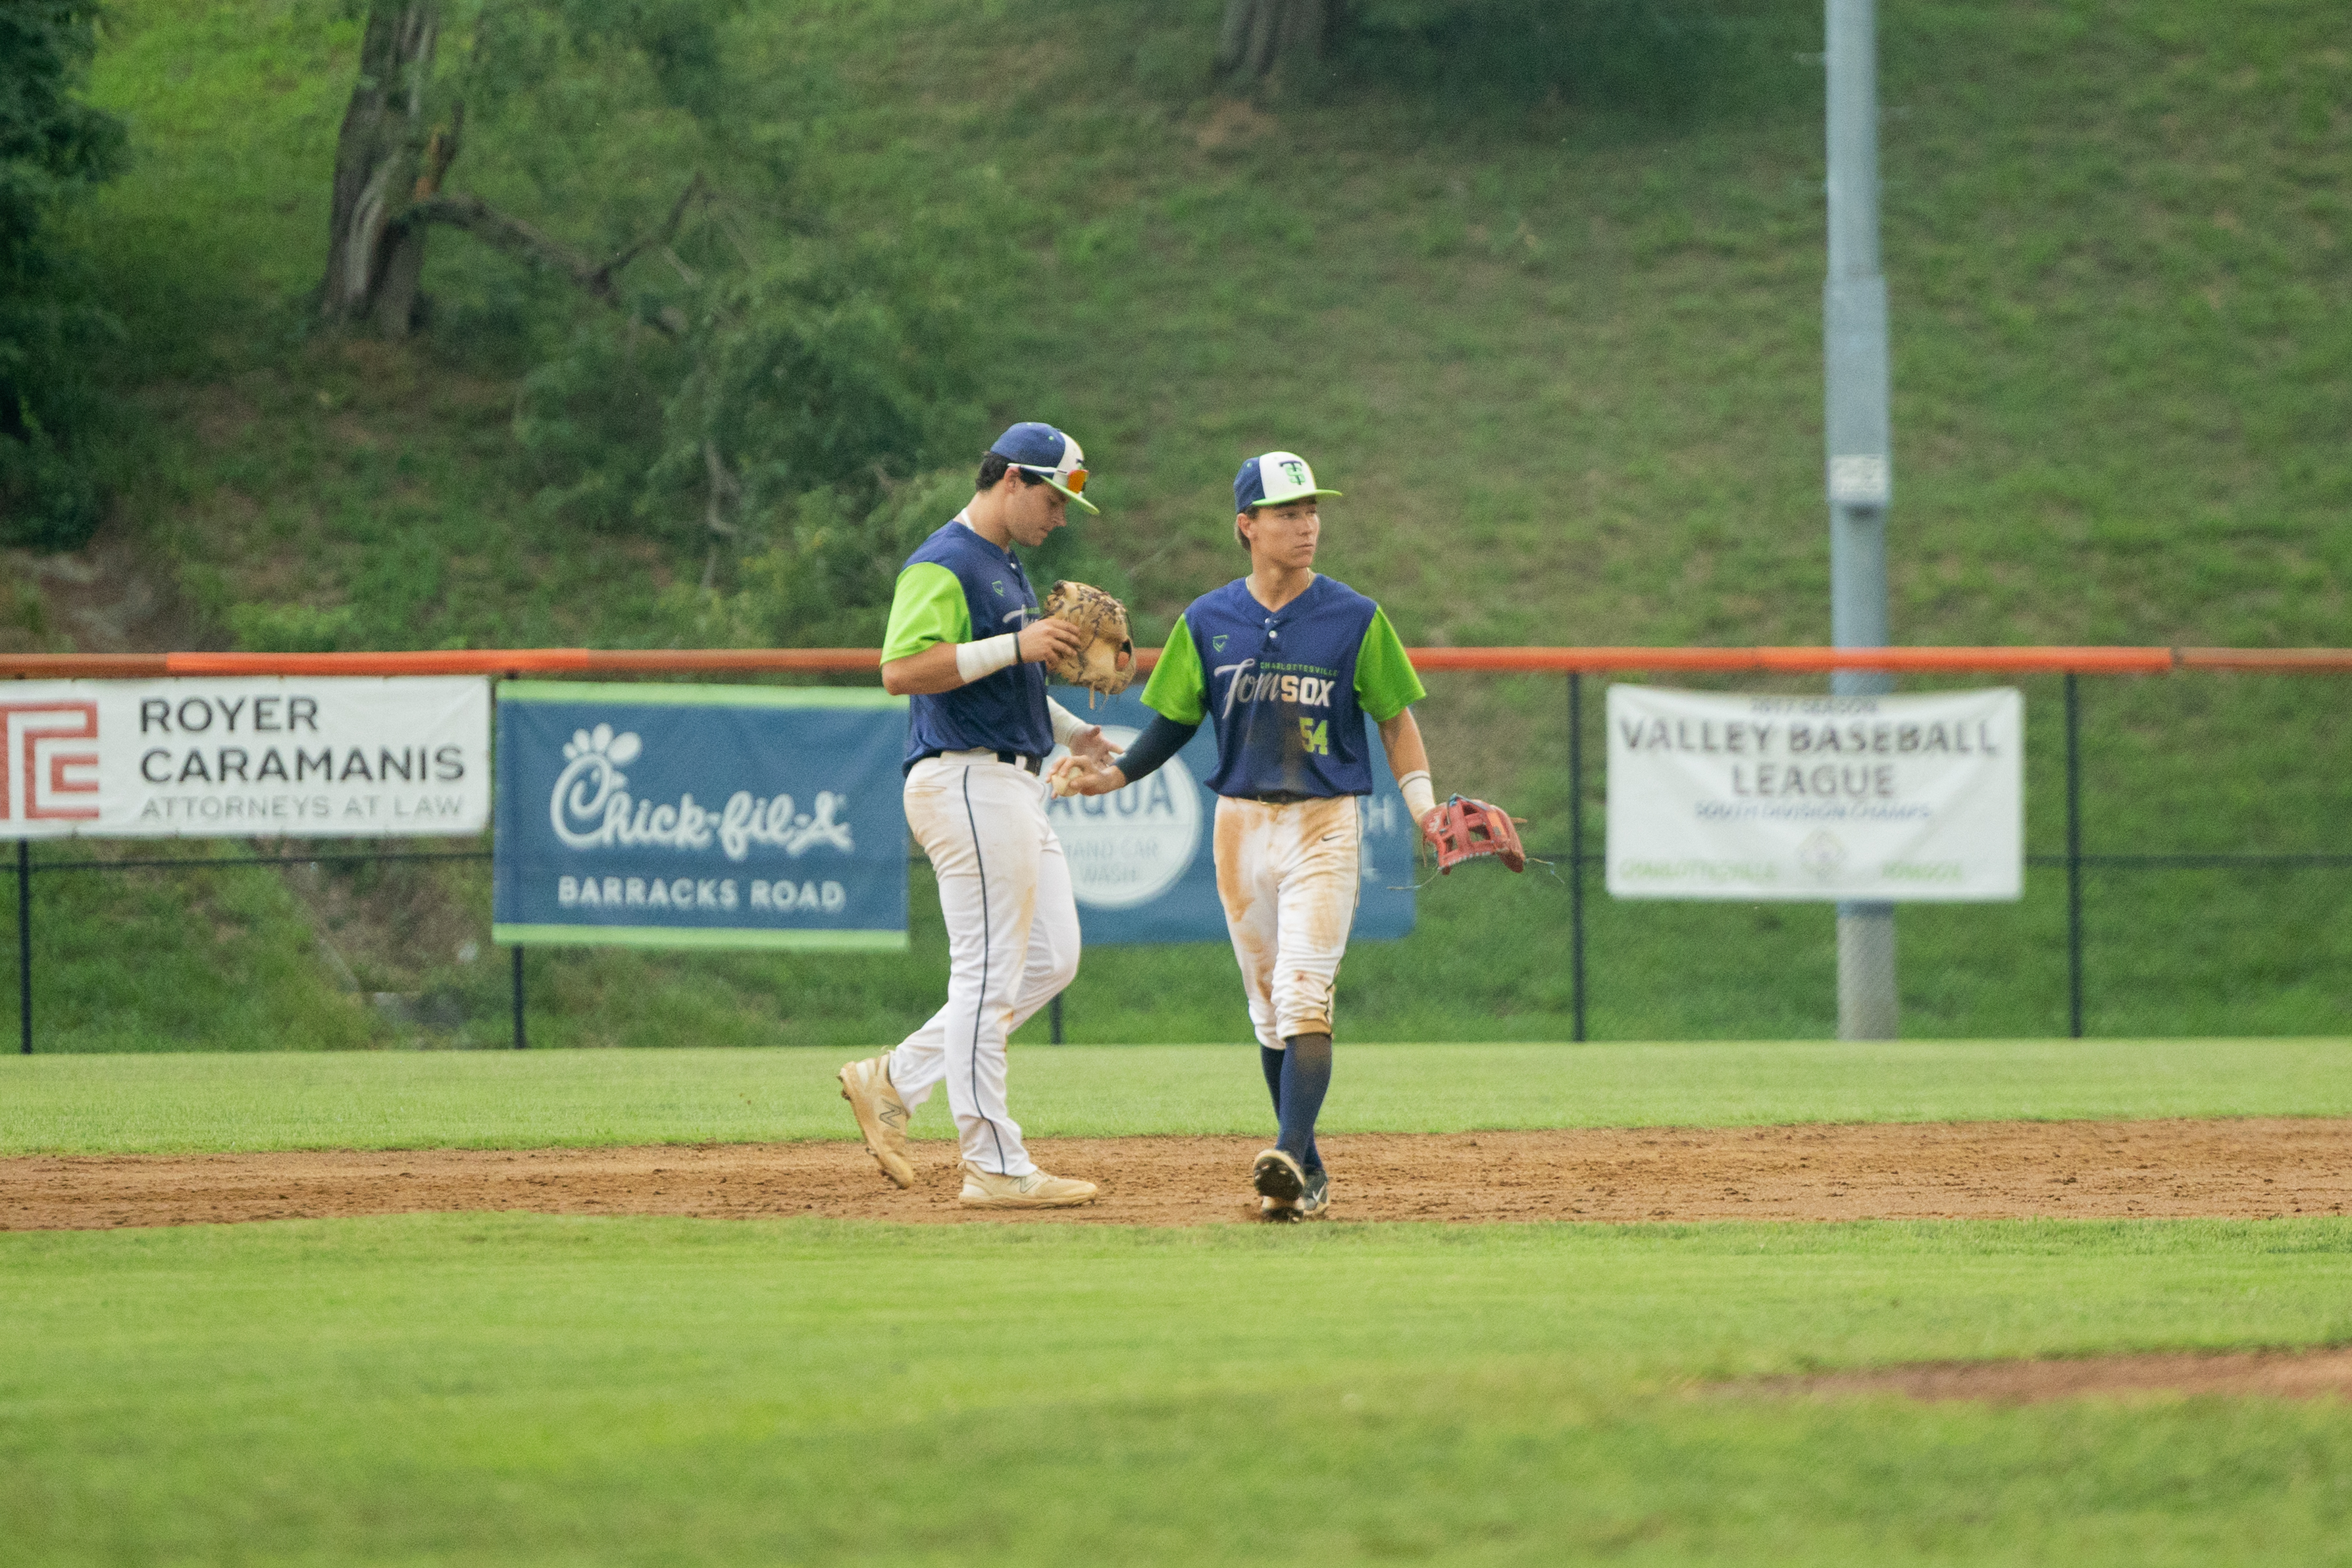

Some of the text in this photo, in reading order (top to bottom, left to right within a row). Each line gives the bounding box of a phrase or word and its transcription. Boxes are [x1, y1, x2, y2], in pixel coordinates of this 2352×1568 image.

[1260, 661, 1339, 678] CHARLOTTESVILLE
[140, 695, 319, 734] ROYER
[1299, 717, 1329, 755] 54
[1618, 717, 2001, 755] VALLEY BASEBALL
[141, 743, 465, 785] CARAMANIS
[1731, 763, 1896, 797] LEAGUE
[141, 795, 463, 820] ATTORNEYS AT LAW
[549, 751, 854, 861] Chick-fil-A
[557, 875, 846, 912] BARRACKS ROAD
